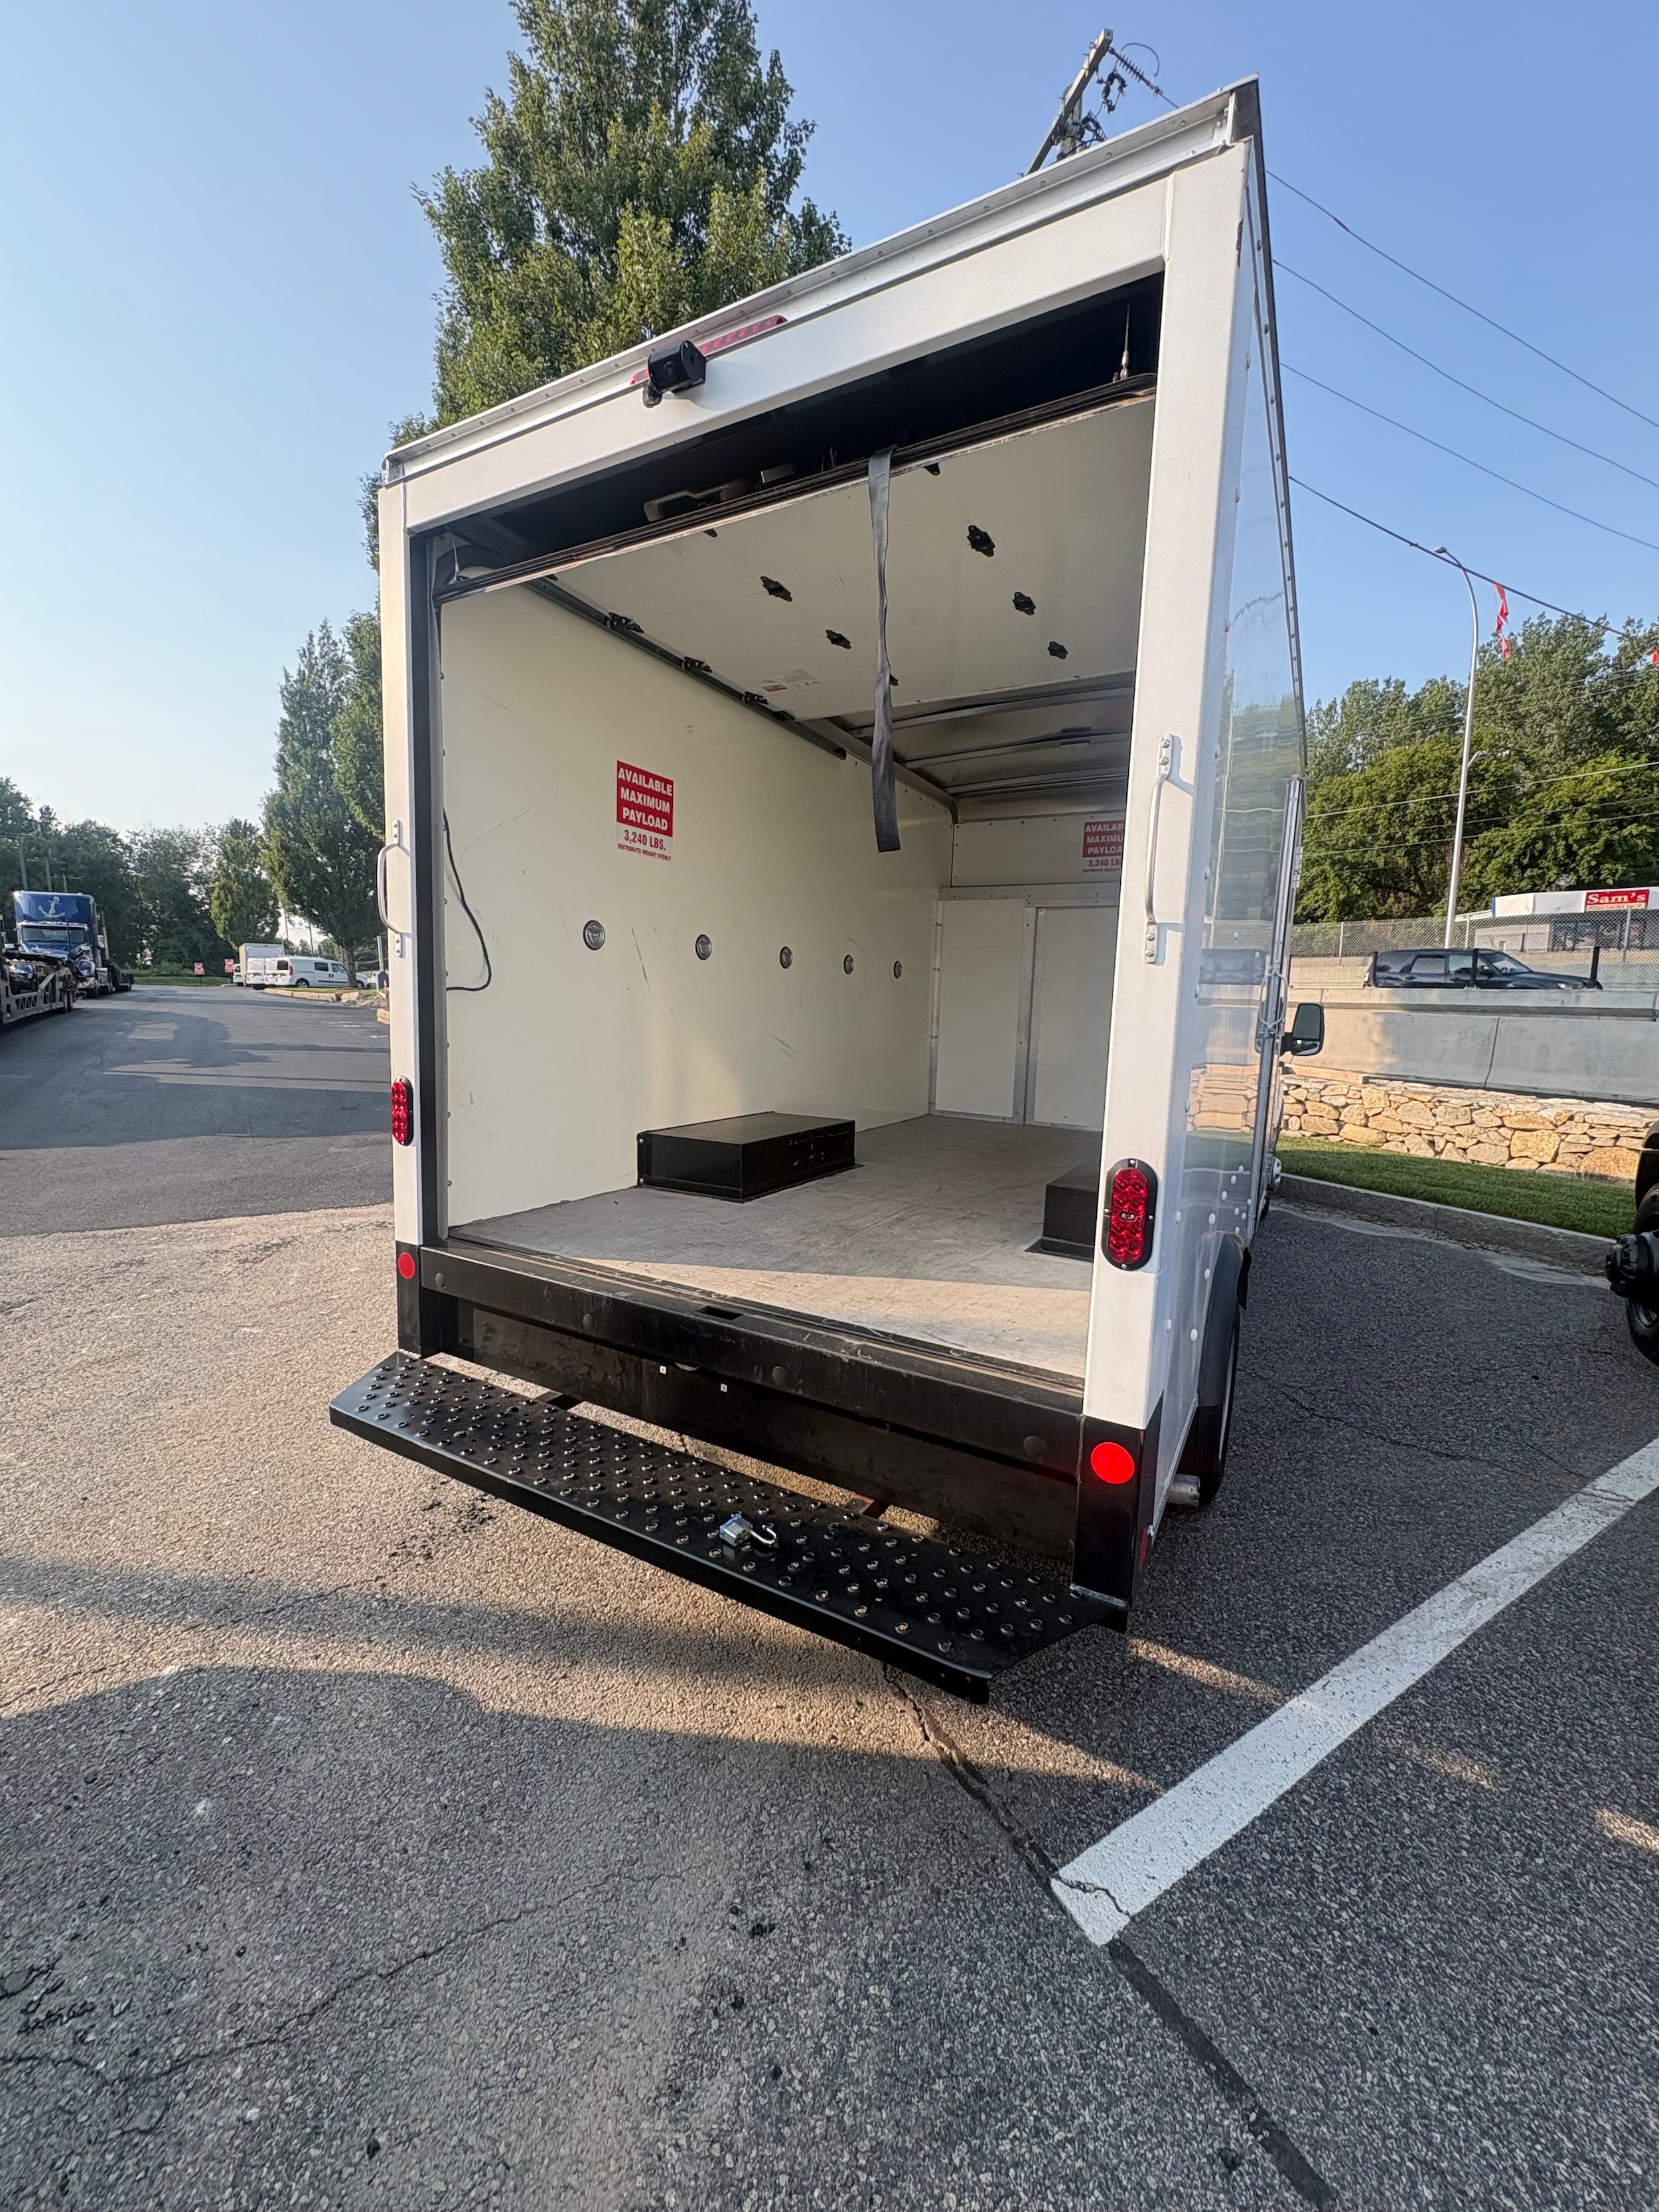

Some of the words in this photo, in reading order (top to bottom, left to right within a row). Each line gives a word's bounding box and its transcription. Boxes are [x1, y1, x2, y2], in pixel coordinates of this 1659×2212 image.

[618, 767, 673, 796] AVAILABLE
[620, 786, 670, 814] MAXIMUM
[622, 806, 668, 831] PAYLOAD
[1085, 823, 1124, 832] AVAILAB
[624, 829, 647, 846] 3,240
[650, 836, 666, 851] LBS.
[1086, 834, 1123, 844] MAXIMU
[618, 843, 641, 854] DISTRIBUTE
[1088, 846, 1122, 855] PAYLOA
[1088, 859, 1109, 867] 3,240
[1587, 892, 1646, 904] Sam's
